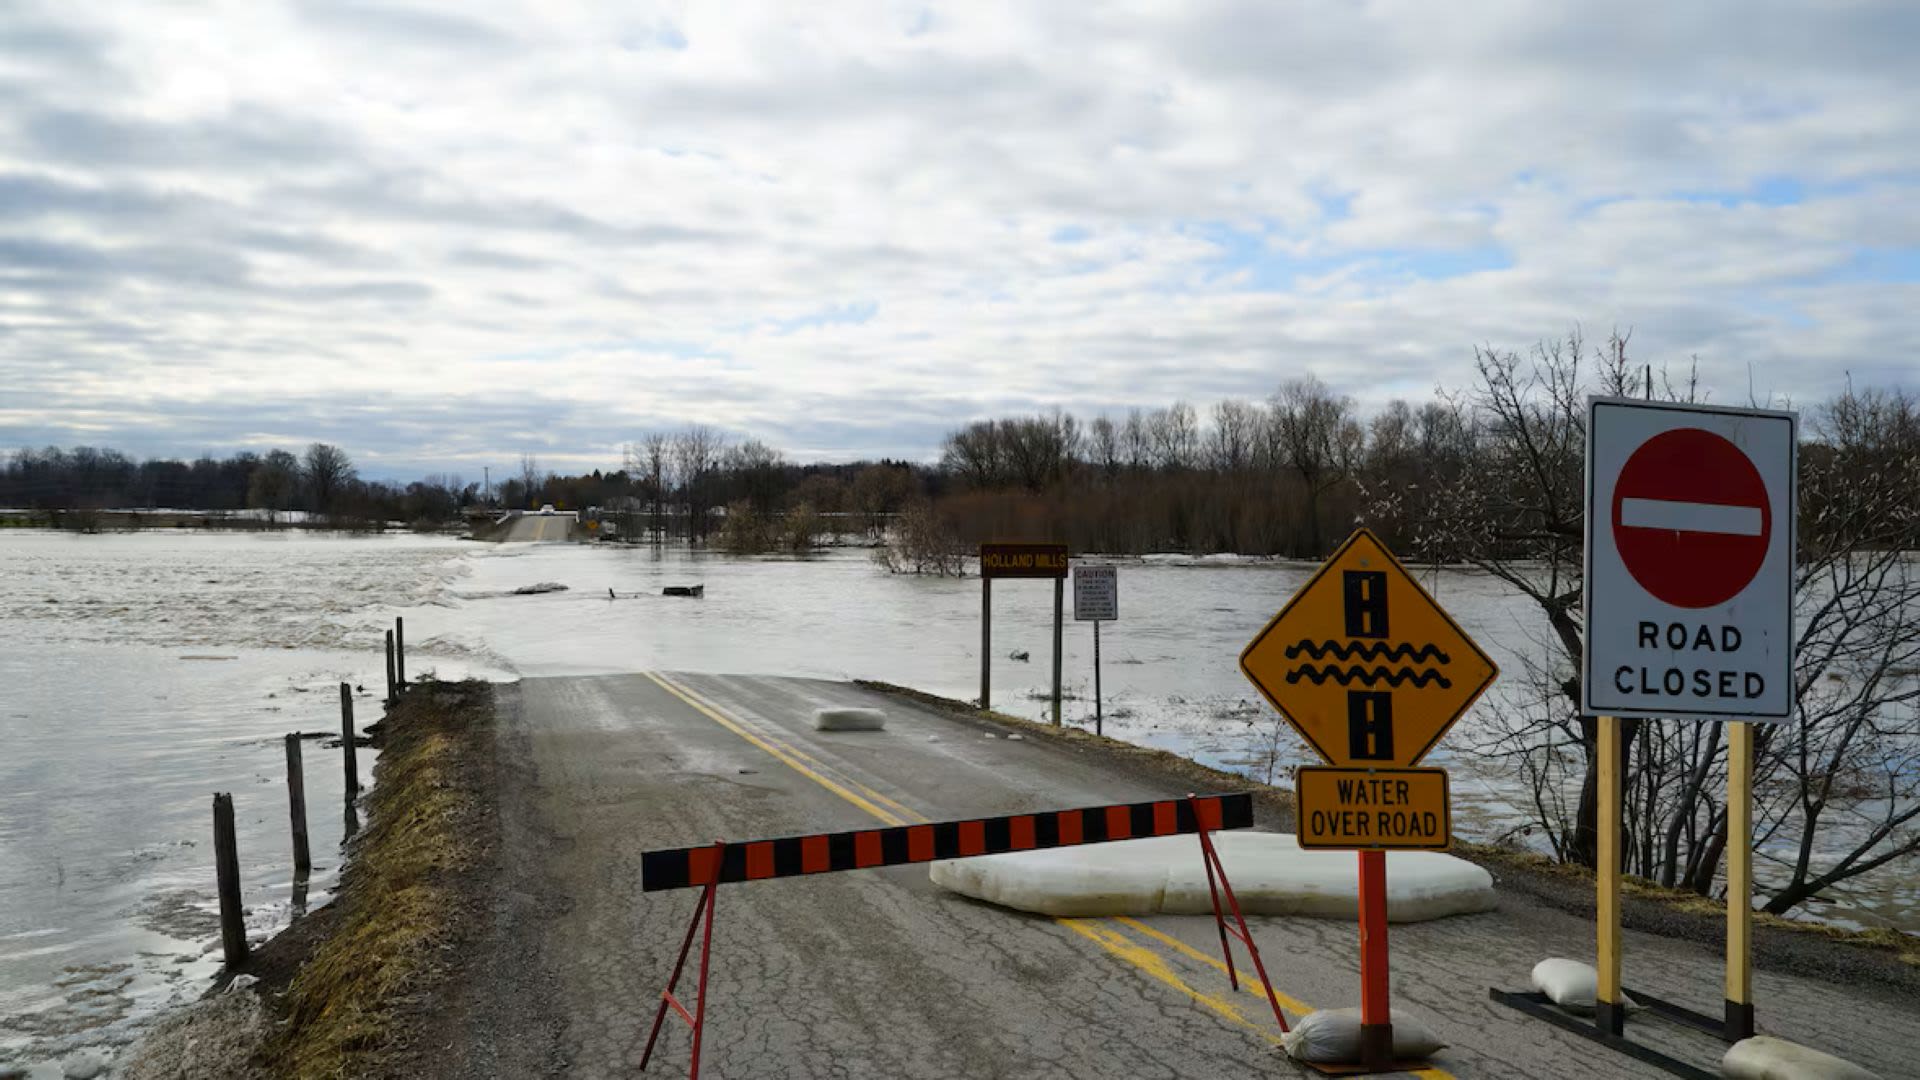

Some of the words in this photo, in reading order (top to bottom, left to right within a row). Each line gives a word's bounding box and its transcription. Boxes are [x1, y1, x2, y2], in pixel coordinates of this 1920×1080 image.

[983, 554, 1032, 568] HOLLAND
[1034, 554, 1066, 568] MILLS
[1077, 569, 1114, 578] CAUTION
[1638, 621, 1742, 652] ROAD
[1614, 665, 1765, 698] CLOSED
[1337, 779, 1409, 805] WATER
[1311, 810, 1370, 836] OVER
[1378, 811, 1437, 837] ROAD
